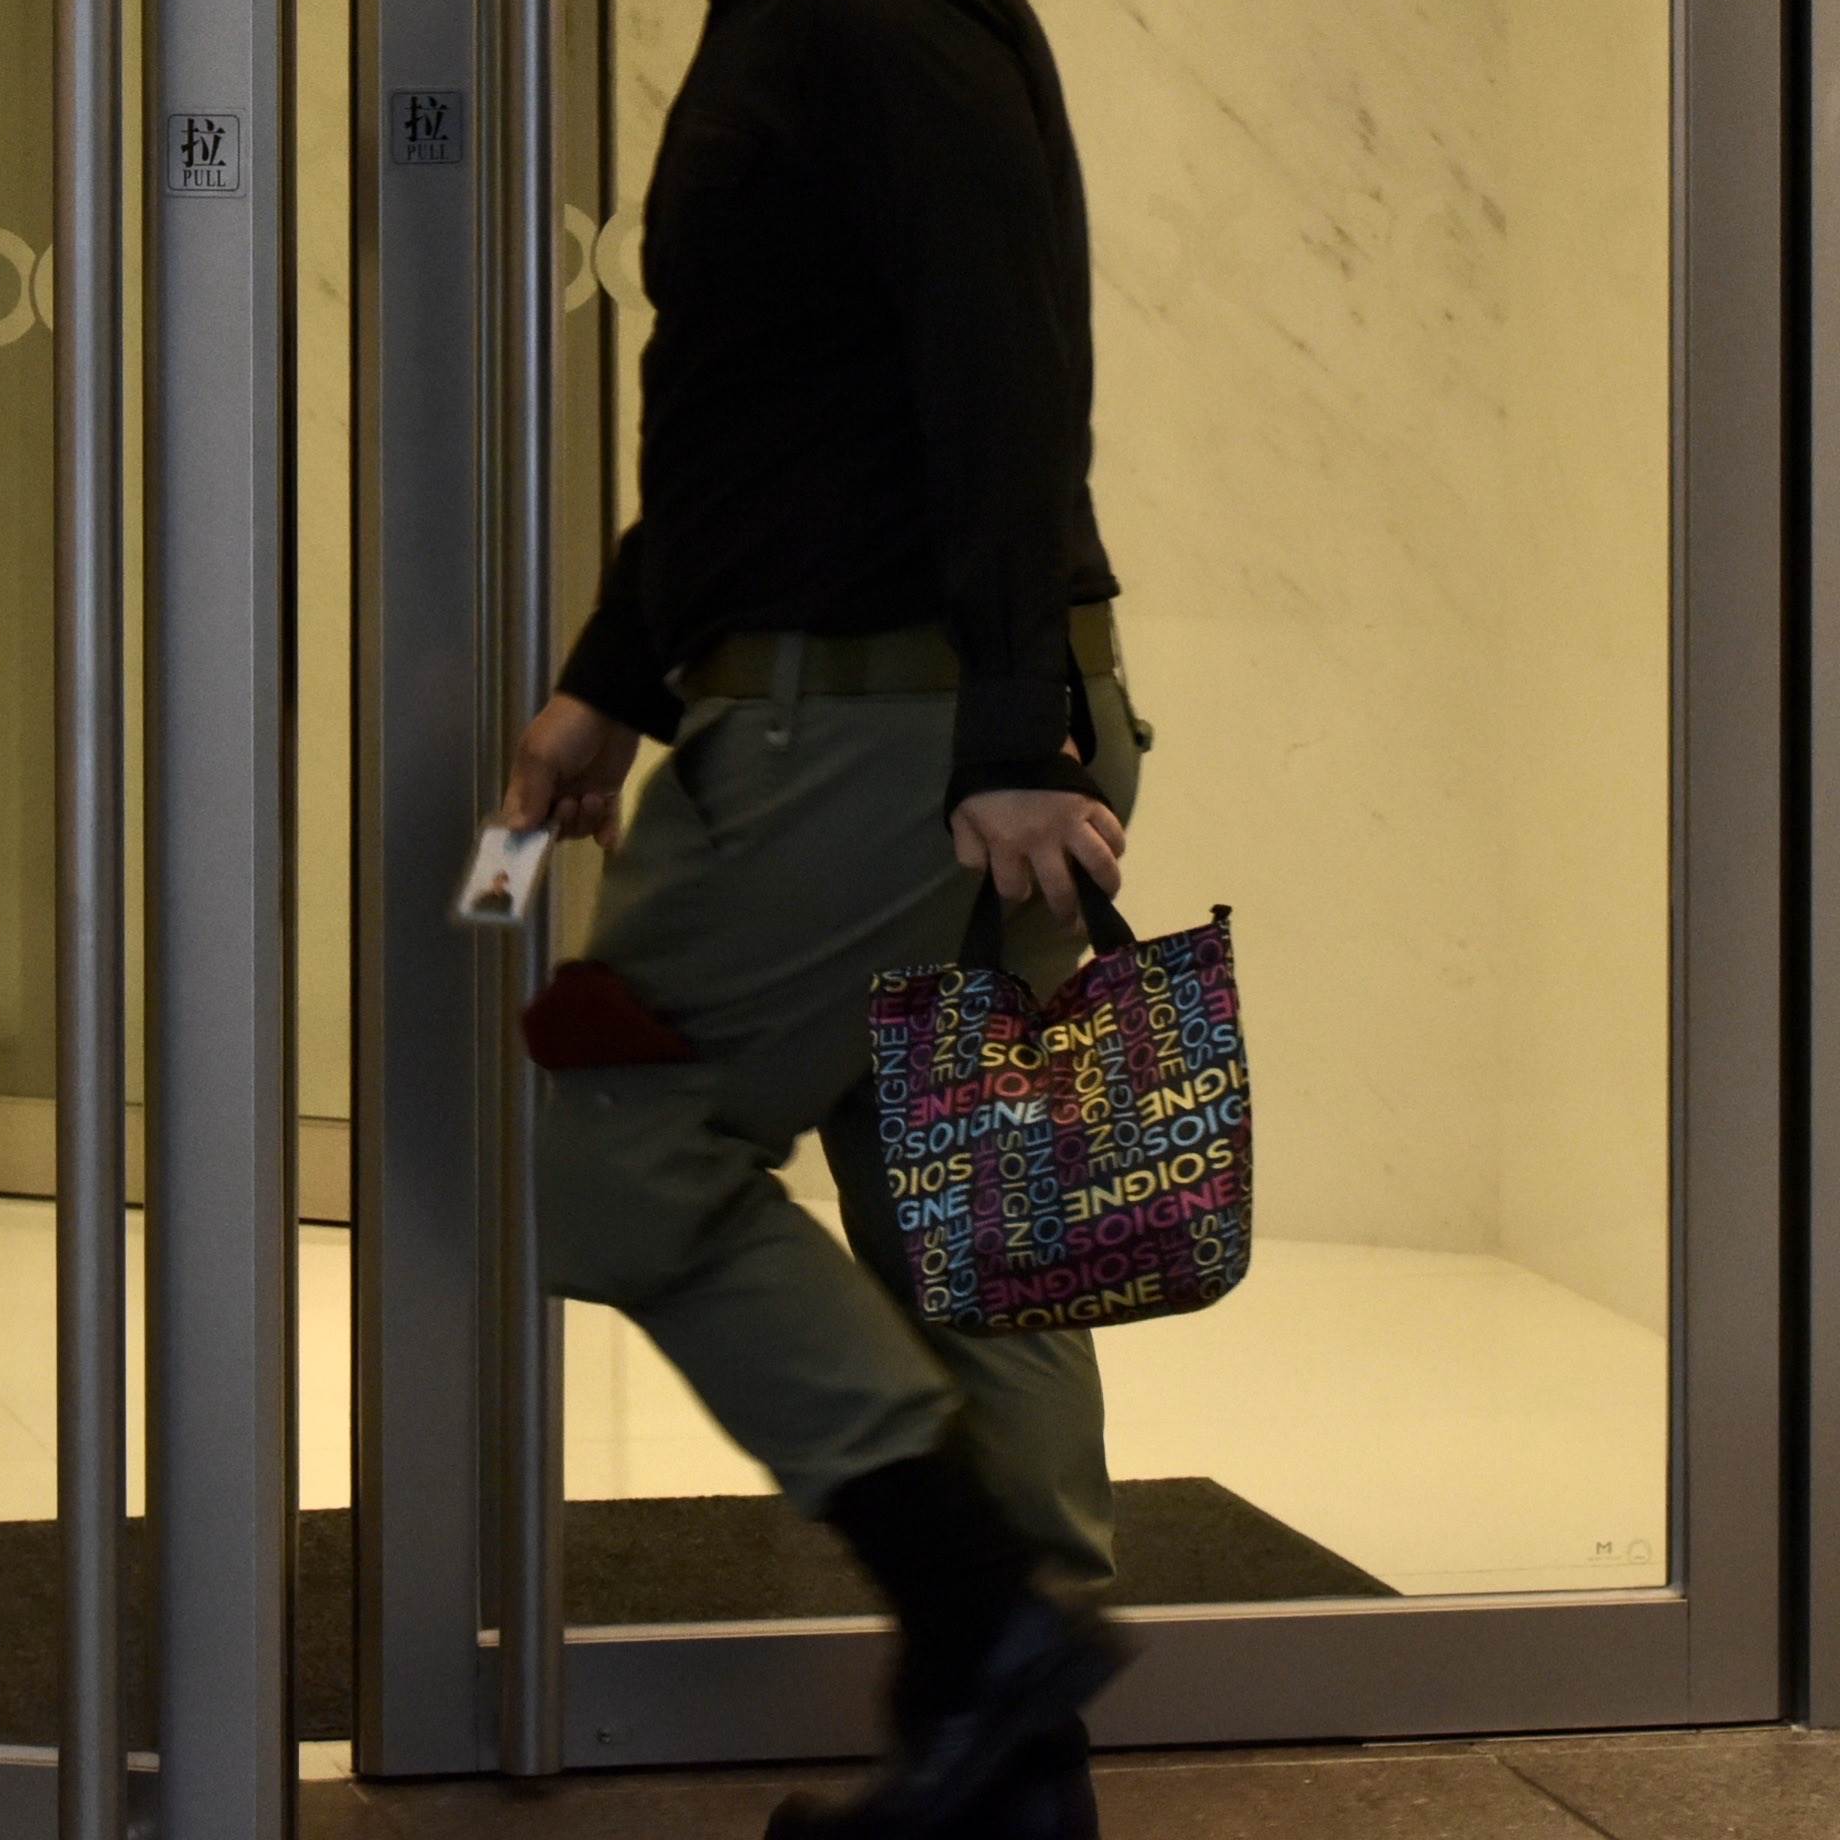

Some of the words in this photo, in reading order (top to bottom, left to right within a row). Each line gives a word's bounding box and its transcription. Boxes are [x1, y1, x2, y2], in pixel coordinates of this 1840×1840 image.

[181, 118, 226, 168] 拉
[404, 95, 449, 142] 拉
[407, 145, 449, 160] PULL
[183, 169, 226, 187] PULL
[1136, 945, 1187, 1079] SOIGNE
[1161, 933, 1213, 1070] SOIGNE
[904, 1094, 1050, 1159] SOIGNE
[1072, 1049, 1119, 1178] SOIGNE
[1097, 1033, 1144, 1168] SOIGNE
[996, 1130, 1036, 1271] SOIGNE
[1023, 1122, 1066, 1265] SOIGNE
[1062, 1138, 1234, 1224] SOIGNE
[1066, 1171, 1236, 1255] SOIGNE
